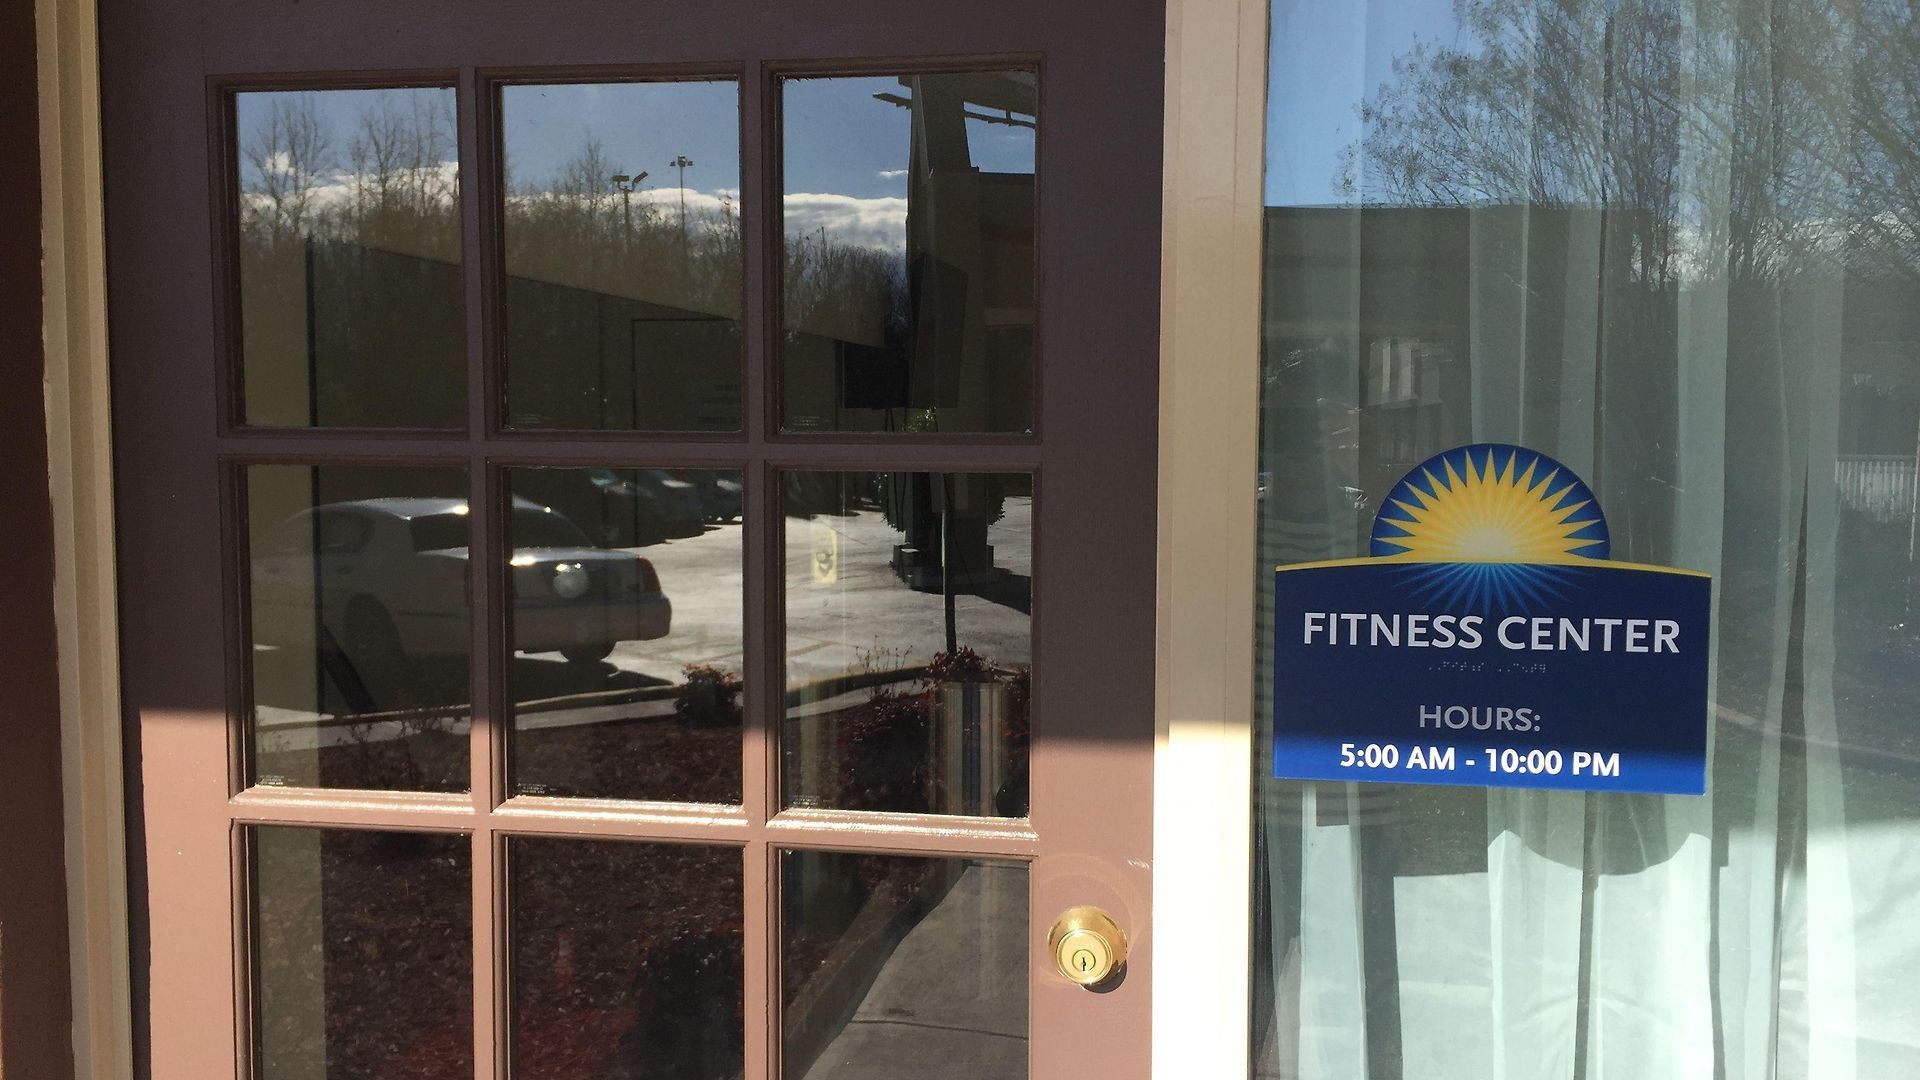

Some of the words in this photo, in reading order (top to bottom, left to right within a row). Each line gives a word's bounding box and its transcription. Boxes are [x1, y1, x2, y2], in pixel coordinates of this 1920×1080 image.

[1304, 612, 1484, 649] FITNESS
[1497, 615, 1681, 653] CENTER
[1419, 704, 1541, 732] HOURS:
[1340, 743, 1400, 768] 5:00
[1406, 746, 1456, 770] AM
[1485, 748, 1563, 775] 10:00
[1572, 751, 1620, 777] PM
